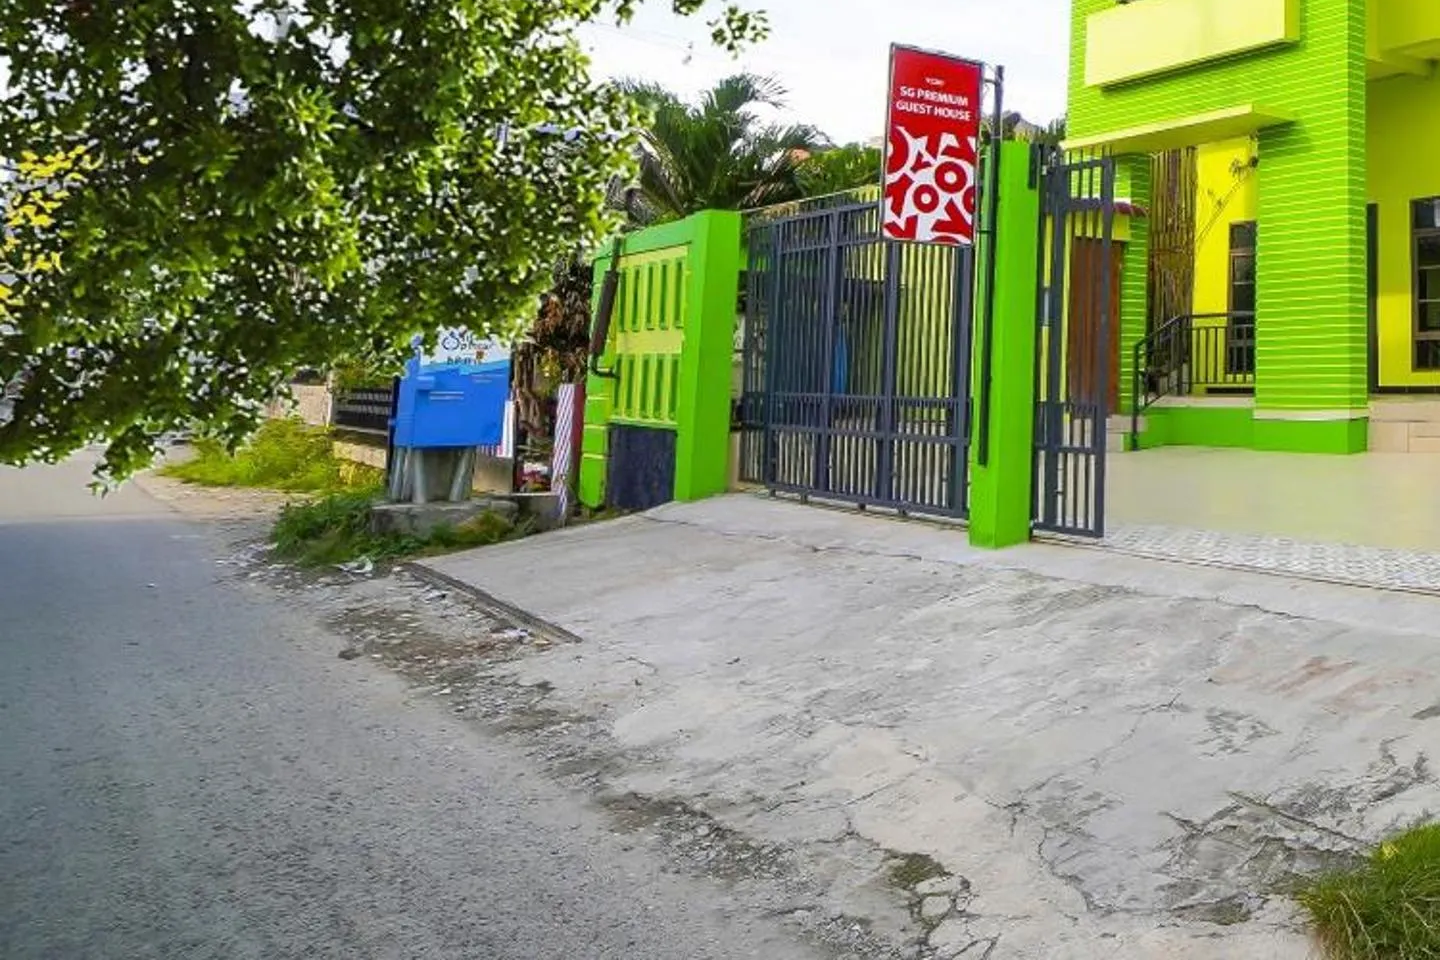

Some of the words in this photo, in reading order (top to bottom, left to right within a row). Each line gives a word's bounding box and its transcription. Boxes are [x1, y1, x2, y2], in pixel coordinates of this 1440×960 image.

[900, 86, 915, 98] SG
[917, 88, 969, 107] PREMIUM
[896, 100, 932, 115] GUEST
[934, 106, 971, 121] HOUSE
